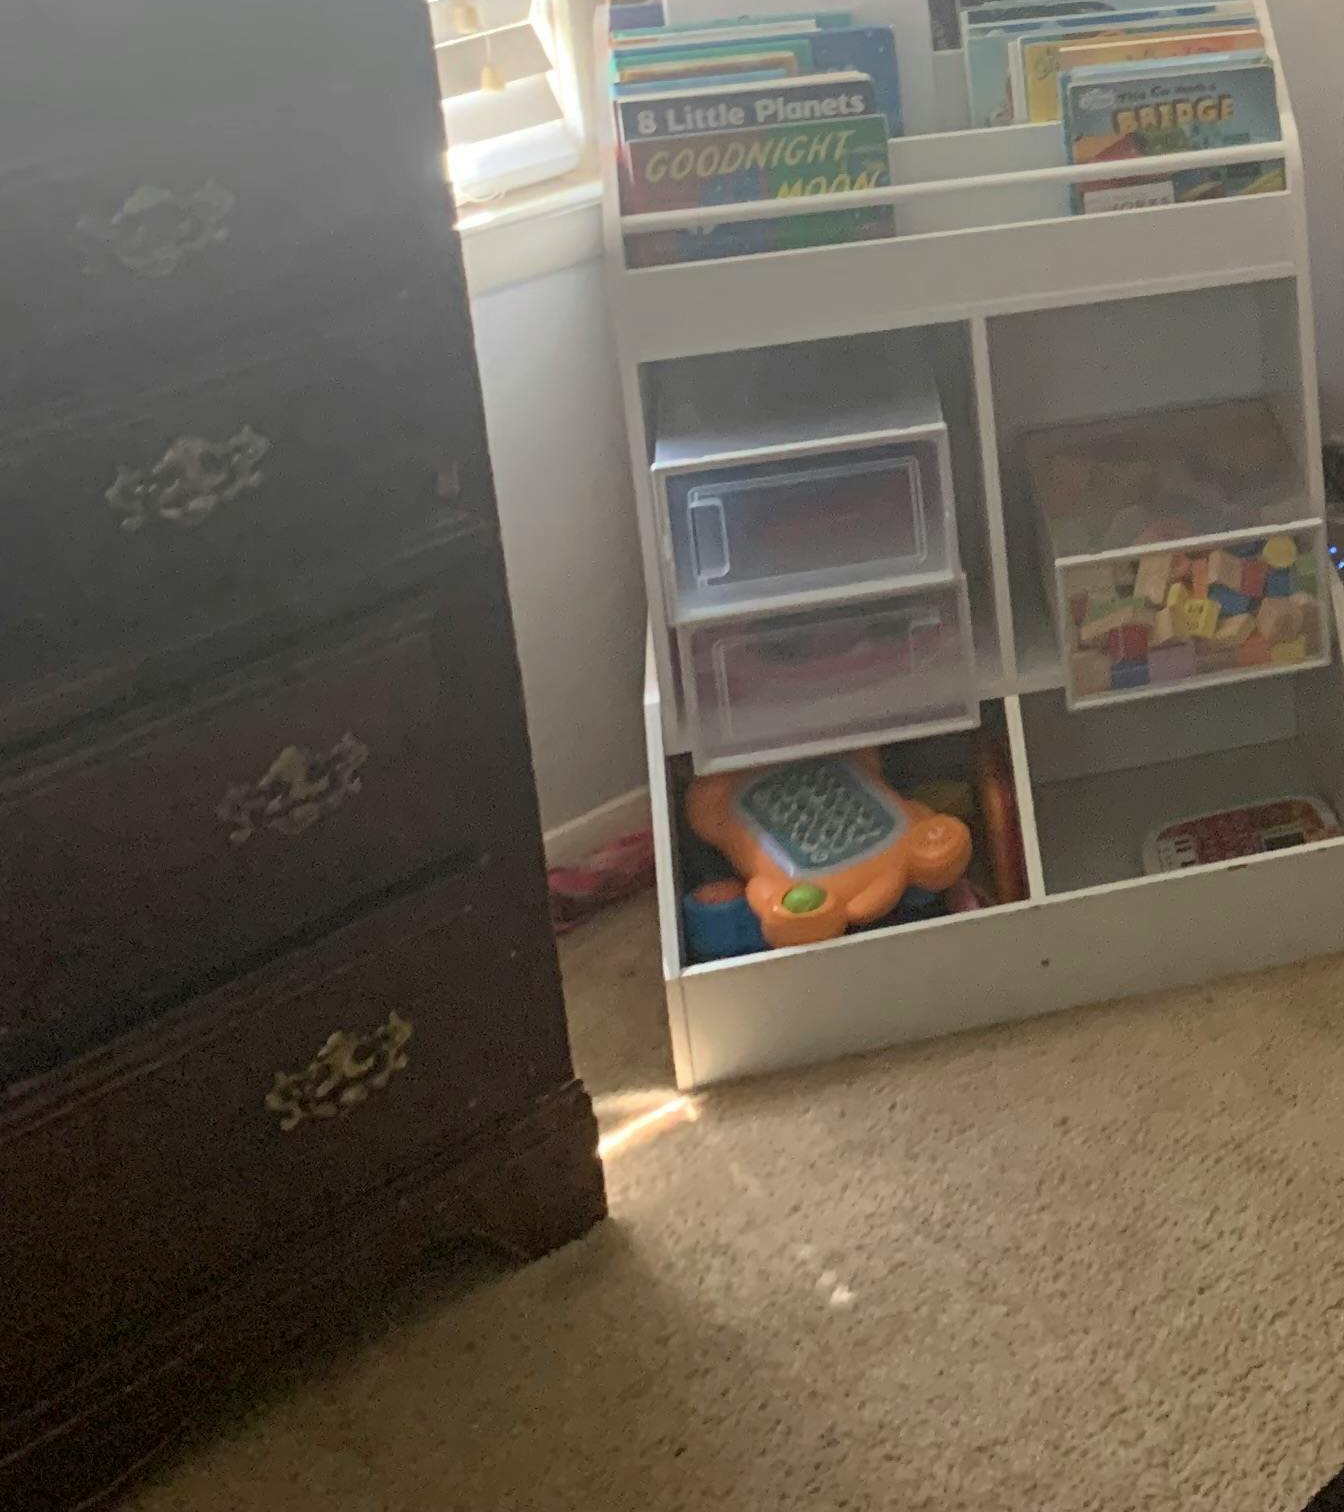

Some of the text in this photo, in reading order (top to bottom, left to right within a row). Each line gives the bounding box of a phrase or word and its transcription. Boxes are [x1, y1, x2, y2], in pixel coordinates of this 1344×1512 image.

[637, 93, 866, 135] 8 Little Planets
[1112, 94, 1236, 134] BRIDGE
[644, 130, 856, 184] GOODNIGHT
[775, 165, 884, 201] MOON
